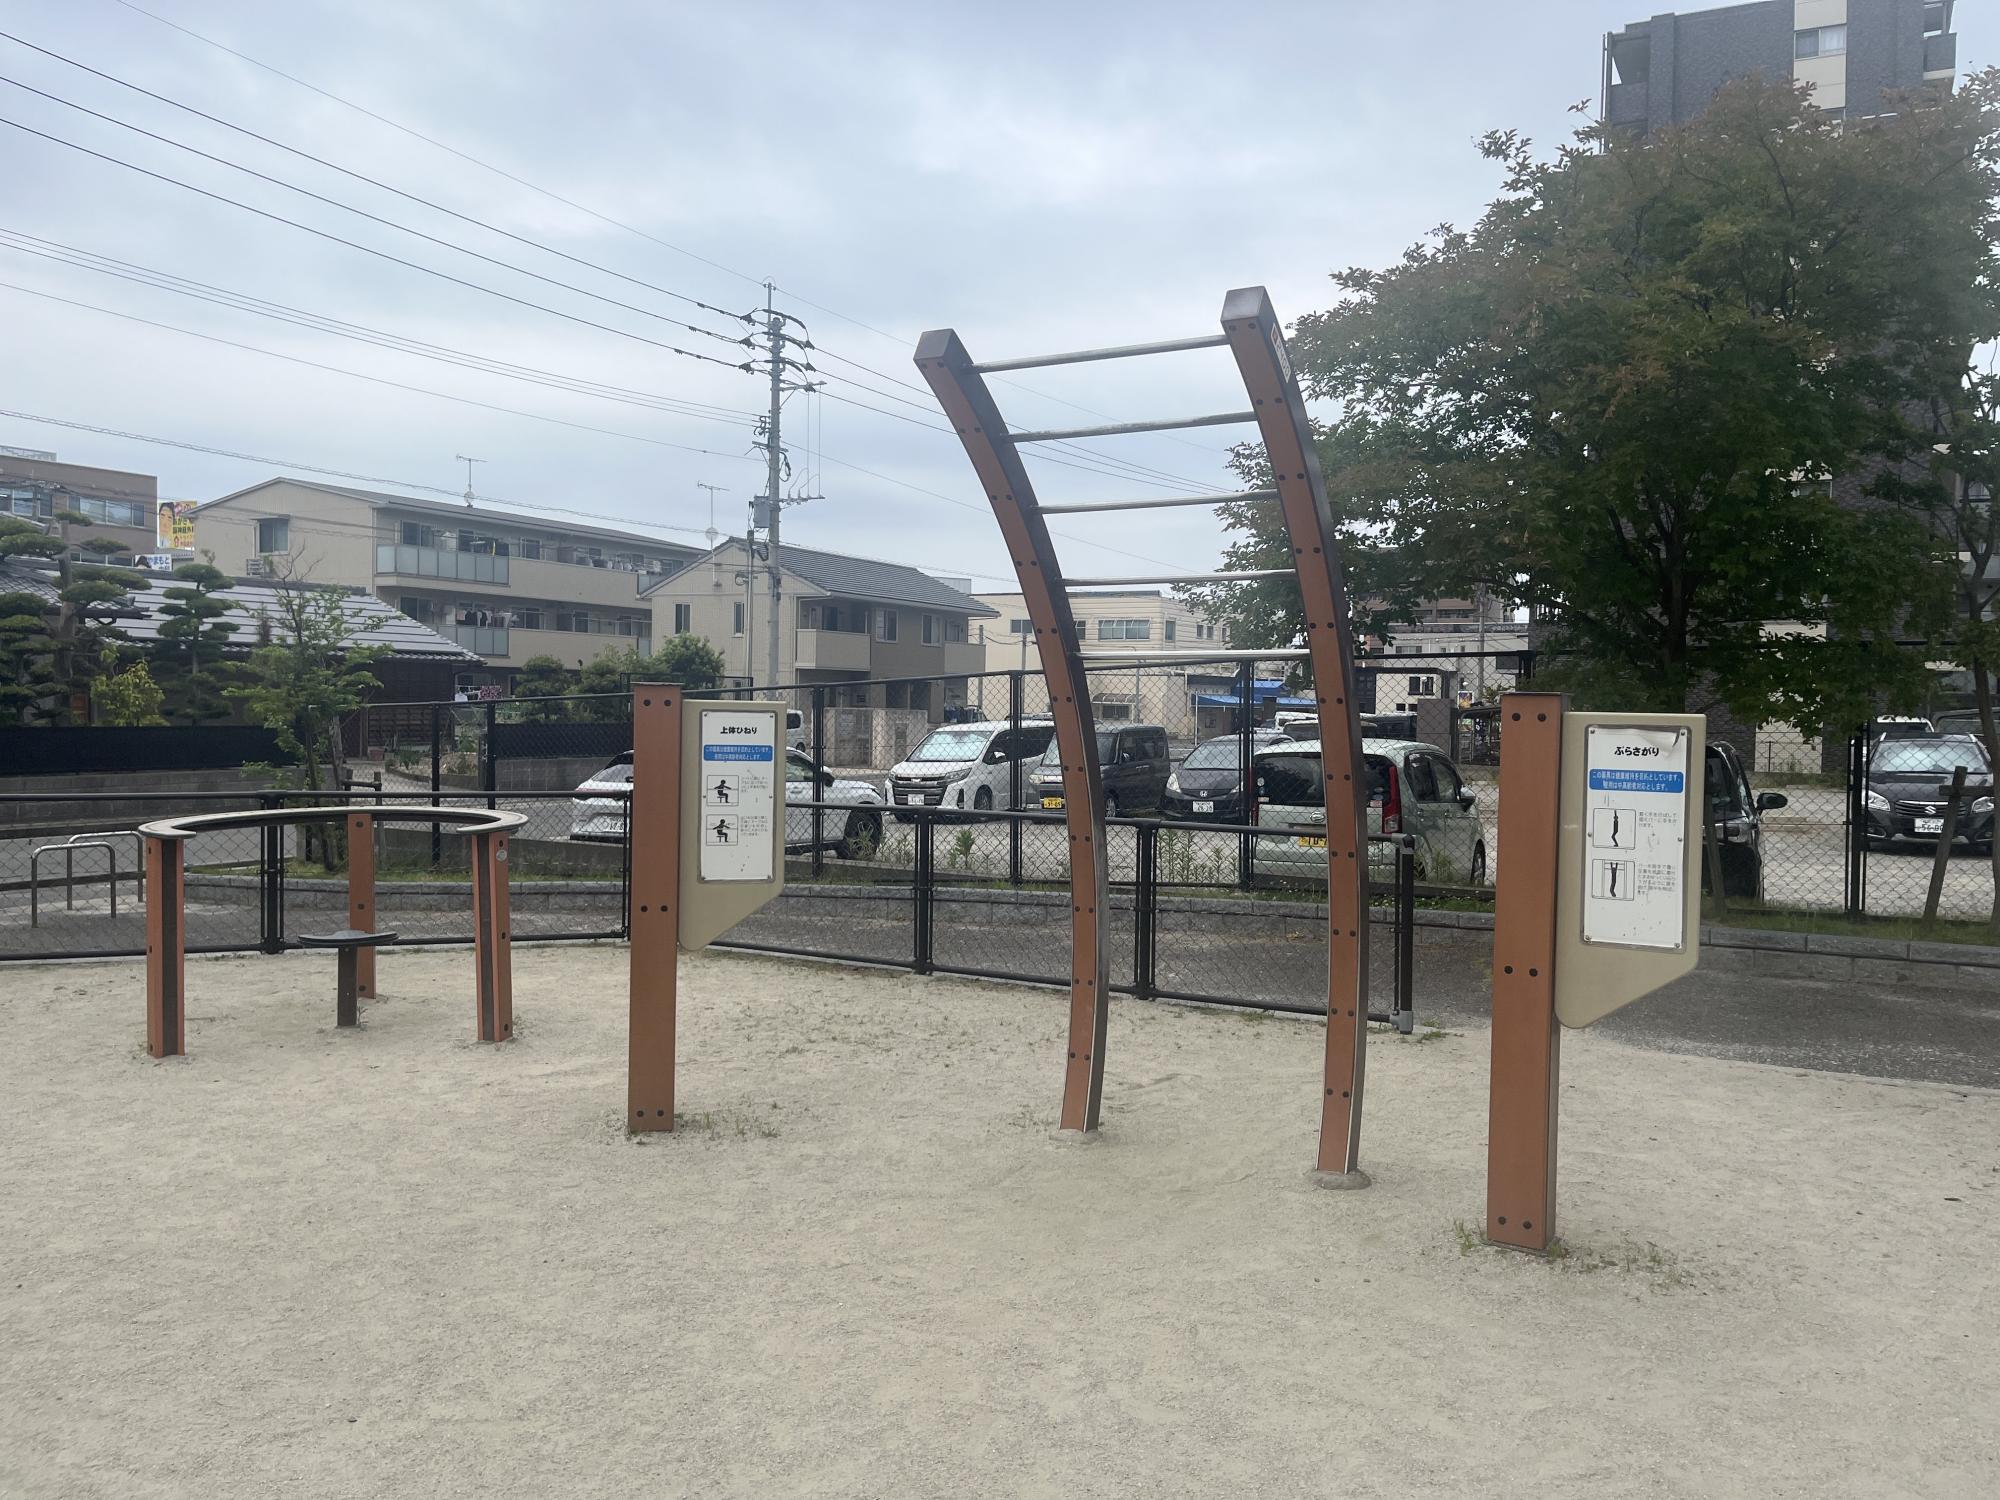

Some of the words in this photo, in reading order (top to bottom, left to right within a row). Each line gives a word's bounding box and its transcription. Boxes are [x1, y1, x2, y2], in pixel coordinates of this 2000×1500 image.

[720, 726, 757, 734] 上体ひねり
[1614, 746, 1659, 756] ぶらさがり
